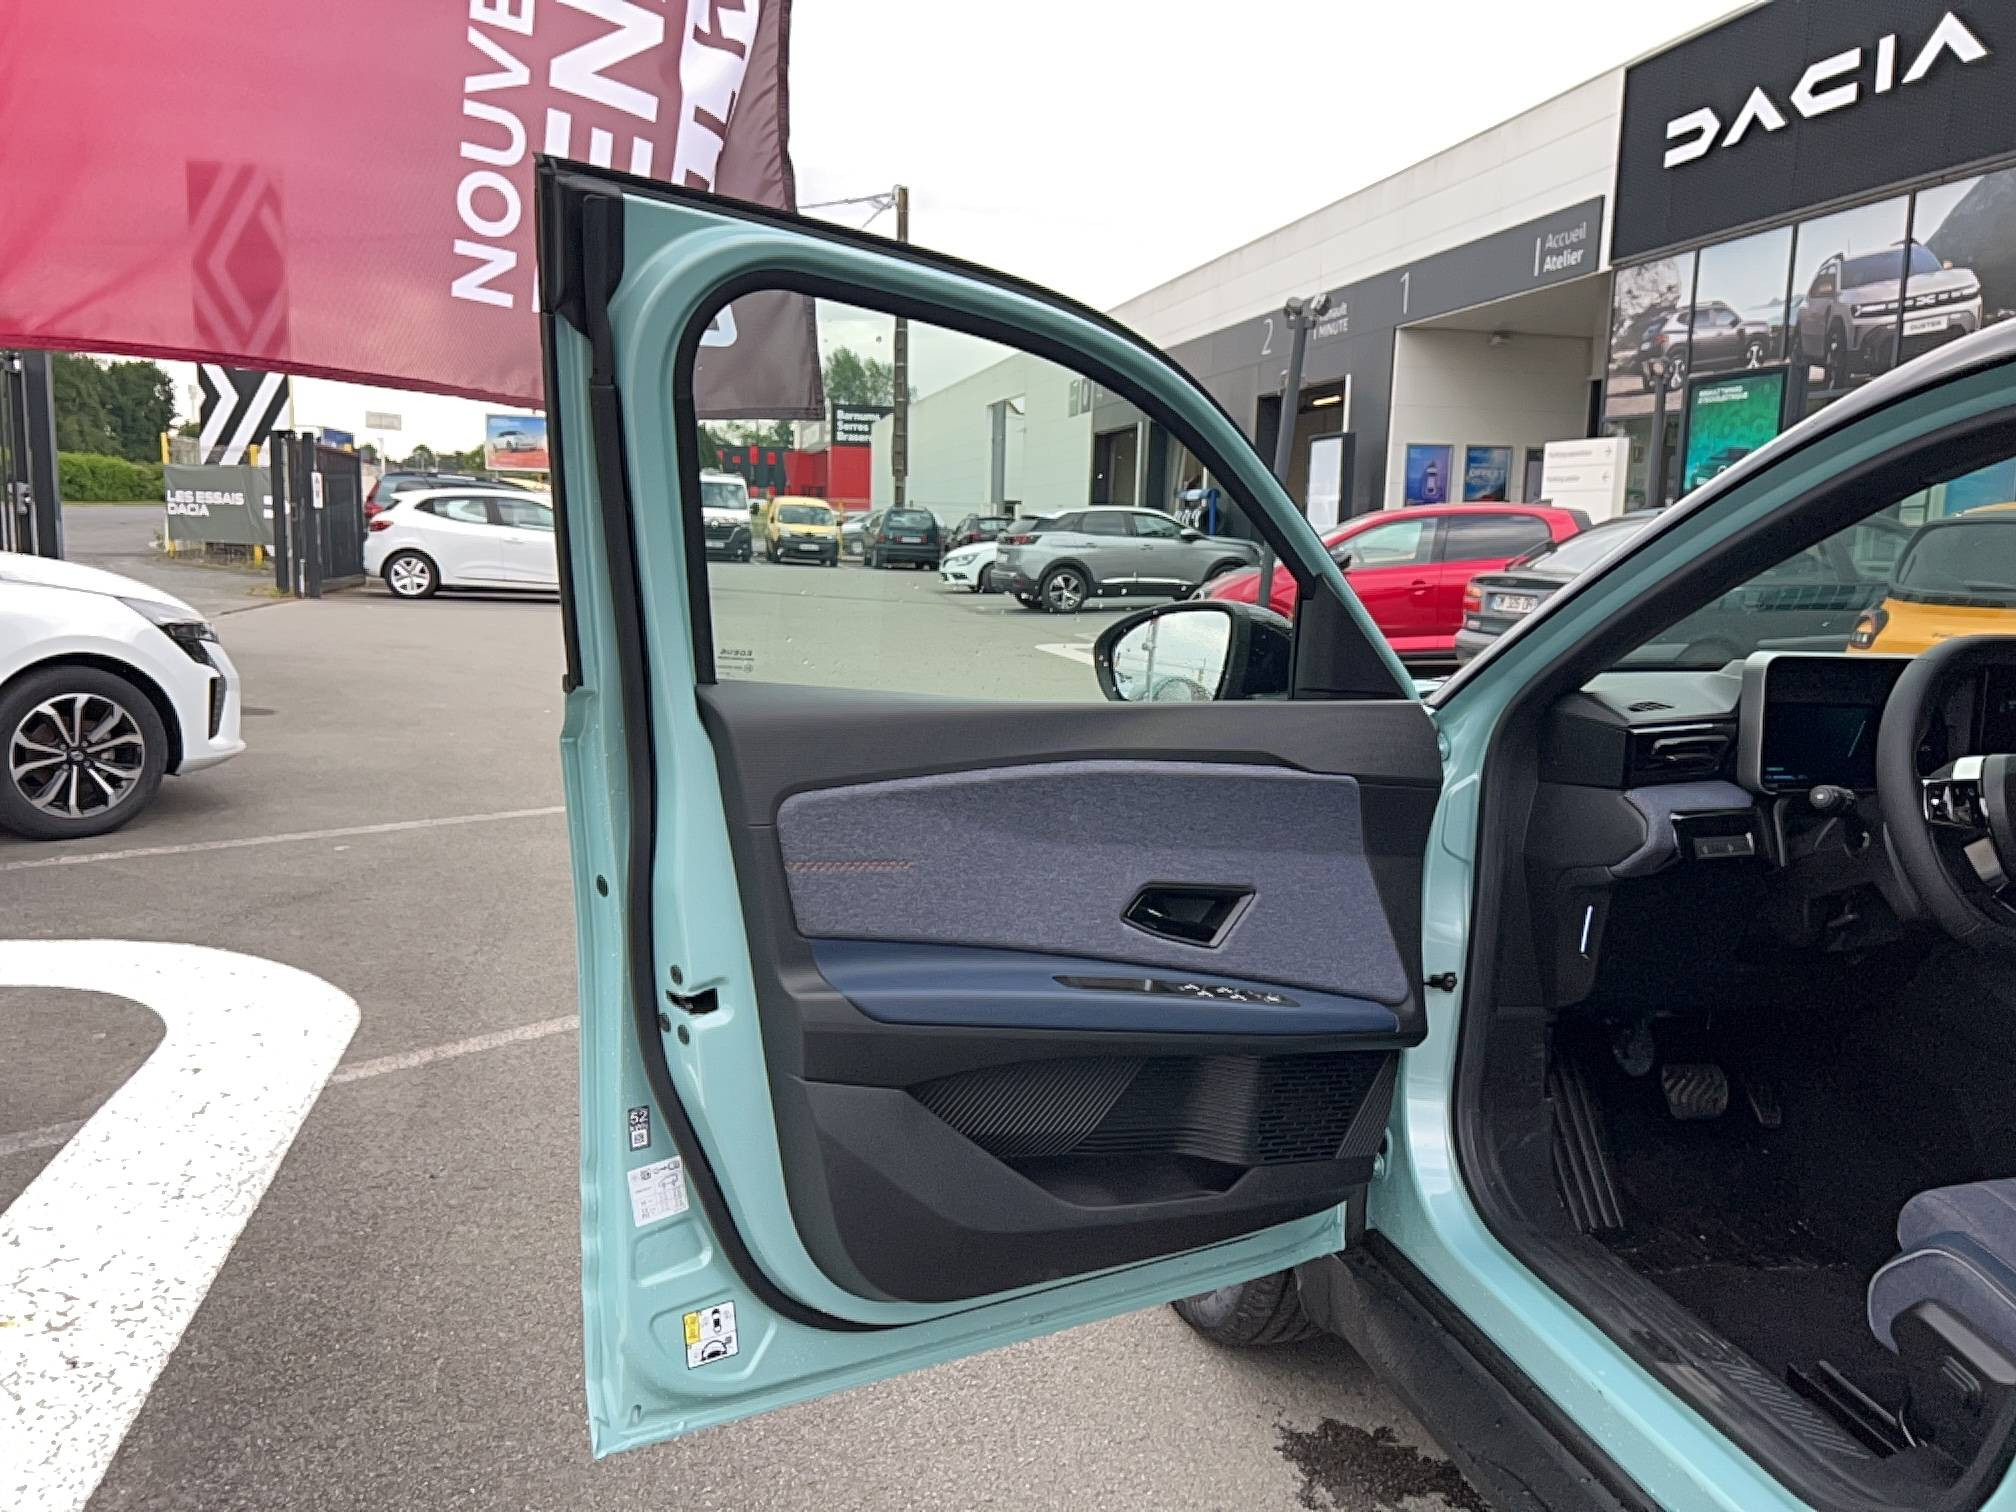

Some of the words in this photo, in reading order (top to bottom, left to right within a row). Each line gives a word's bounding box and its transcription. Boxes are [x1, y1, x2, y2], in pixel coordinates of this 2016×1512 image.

[1663, 11, 1988, 168] DACIA
[1544, 221, 1587, 251] Accueil
[1543, 248, 1584, 273] Atelier
[1400, 271, 1411, 315] 1
[1261, 318, 1274, 355] 2
[1319, 317, 1350, 338] MINUTE
[167, 489, 194, 504] LES
[195, 490, 245, 506] ESSAIS
[167, 502, 210, 517] DACIA
